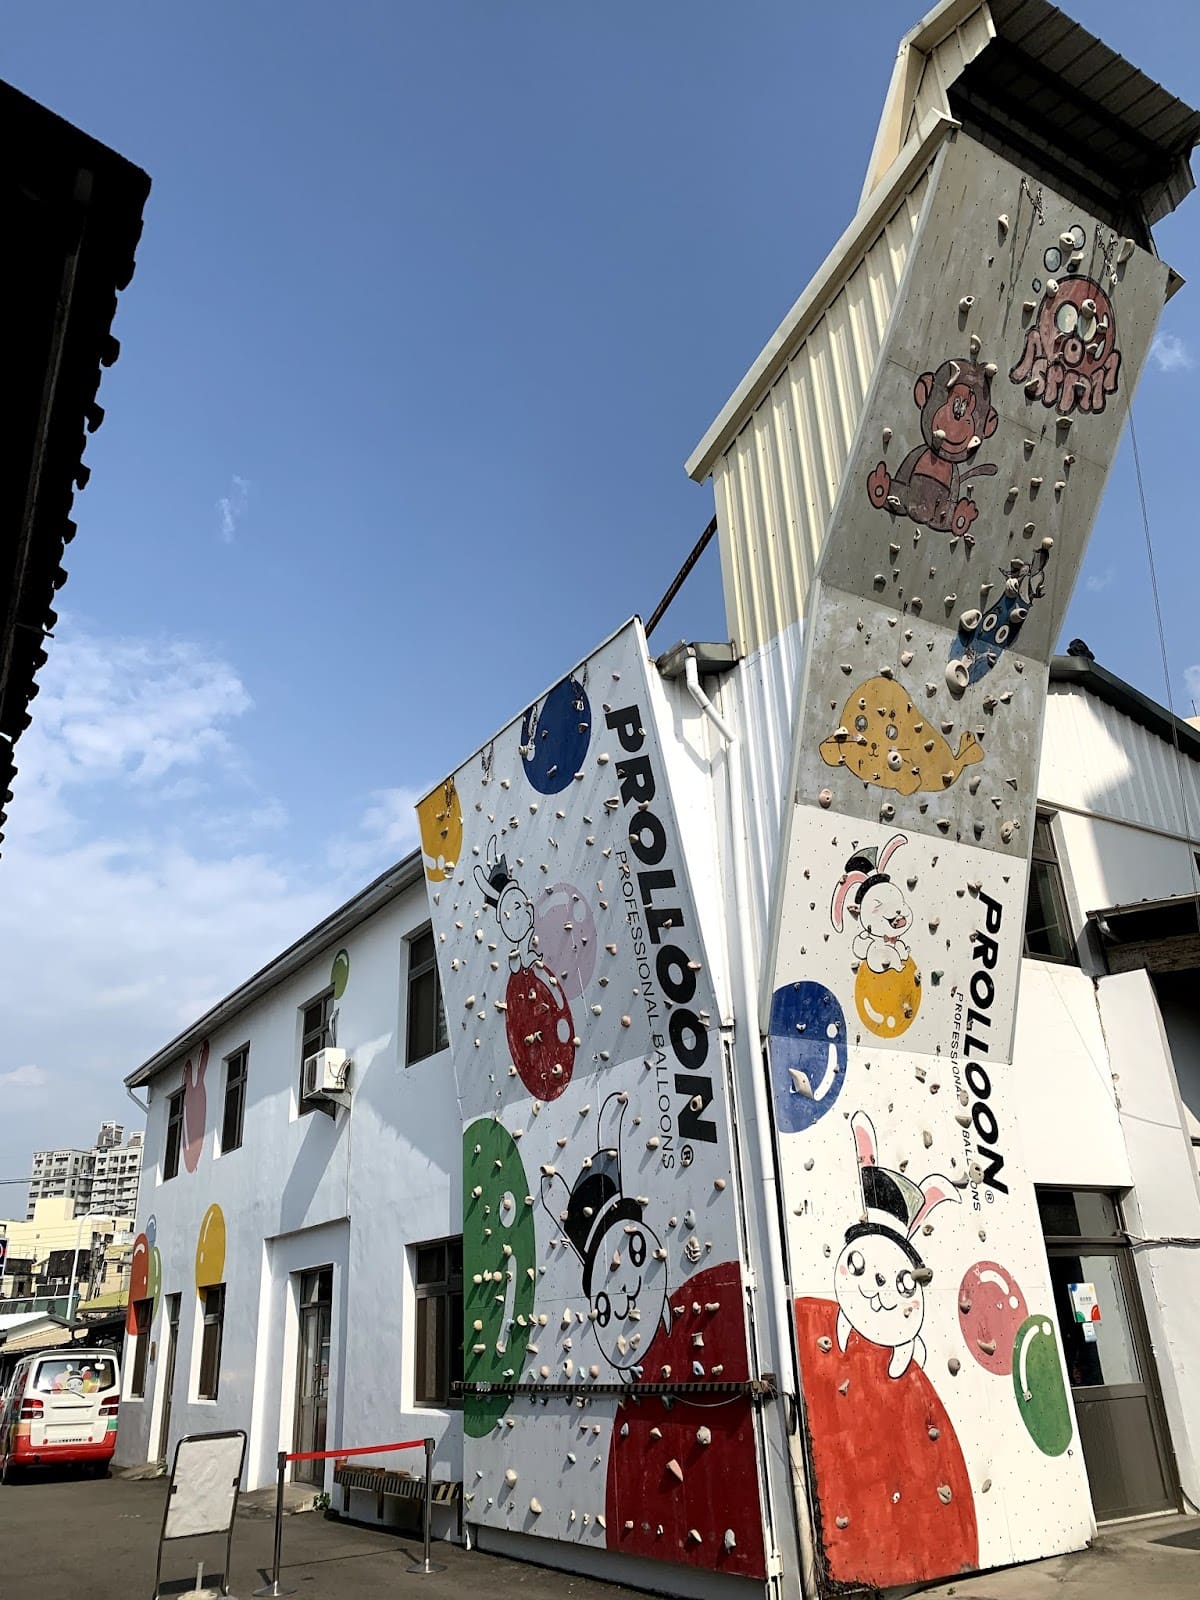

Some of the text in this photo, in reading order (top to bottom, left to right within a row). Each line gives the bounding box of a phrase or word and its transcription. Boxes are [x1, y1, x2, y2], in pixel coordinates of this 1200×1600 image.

[605, 704, 718, 1144] PROLLOON
[615, 851, 675, 1169] PROFESSIONAL BALLOONS
[963, 890, 1009, 1195] PROLLOON
[962, 1129, 981, 1212] BALLONS
